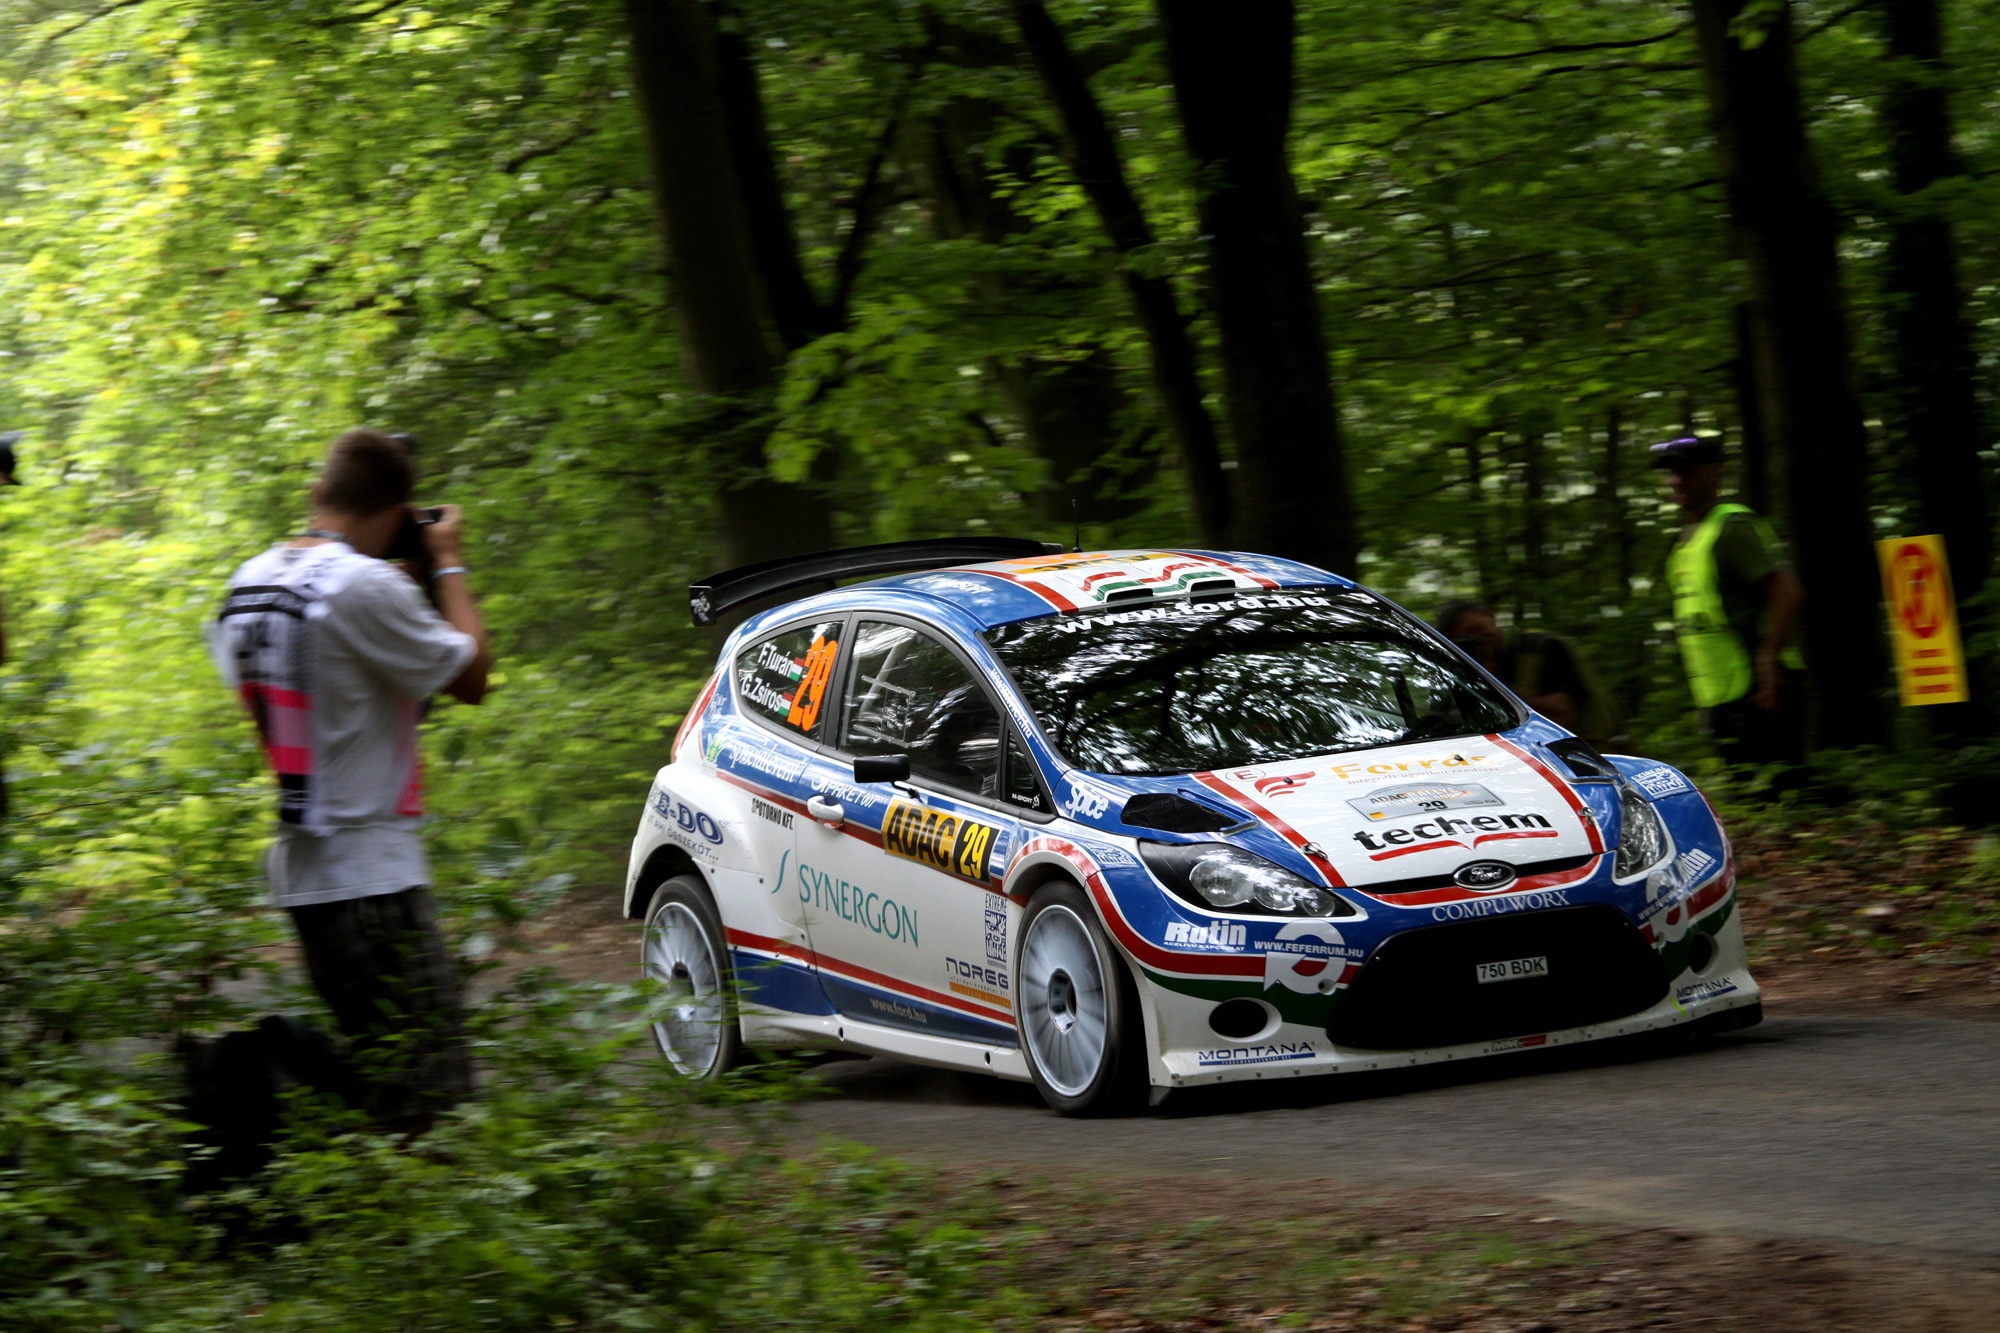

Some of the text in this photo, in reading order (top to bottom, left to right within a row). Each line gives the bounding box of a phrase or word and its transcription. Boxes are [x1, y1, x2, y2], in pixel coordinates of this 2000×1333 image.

[1053, 592, 1331, 634] www.ford.hu
[757, 641, 794, 678] F.Turán
[787, 635, 838, 731] 29
[1233, 769, 1252, 781] E
[751, 798, 781, 826] SPOTORNO
[1011, 793, 1033, 804] M-SPORT
[1369, 793, 1408, 804] ADAC
[1418, 800, 1448, 811] 29
[887, 806, 991, 881] ADAC 29
[1353, 812, 1553, 850] techem
[1469, 867, 1502, 883] Ford
[799, 863, 919, 949] SYNERGON
[1432, 890, 1570, 921] COMPUWORX
[1163, 920, 1247, 946] Rutin
[1254, 940, 1364, 958] WWW.FEFERRUM.HU
[945, 956, 1009, 990] NOREG
[1479, 957, 1545, 979] 750 BDK
[869, 997, 928, 1024] www.ford.hu
[1199, 1042, 1313, 1060] MONTANA
